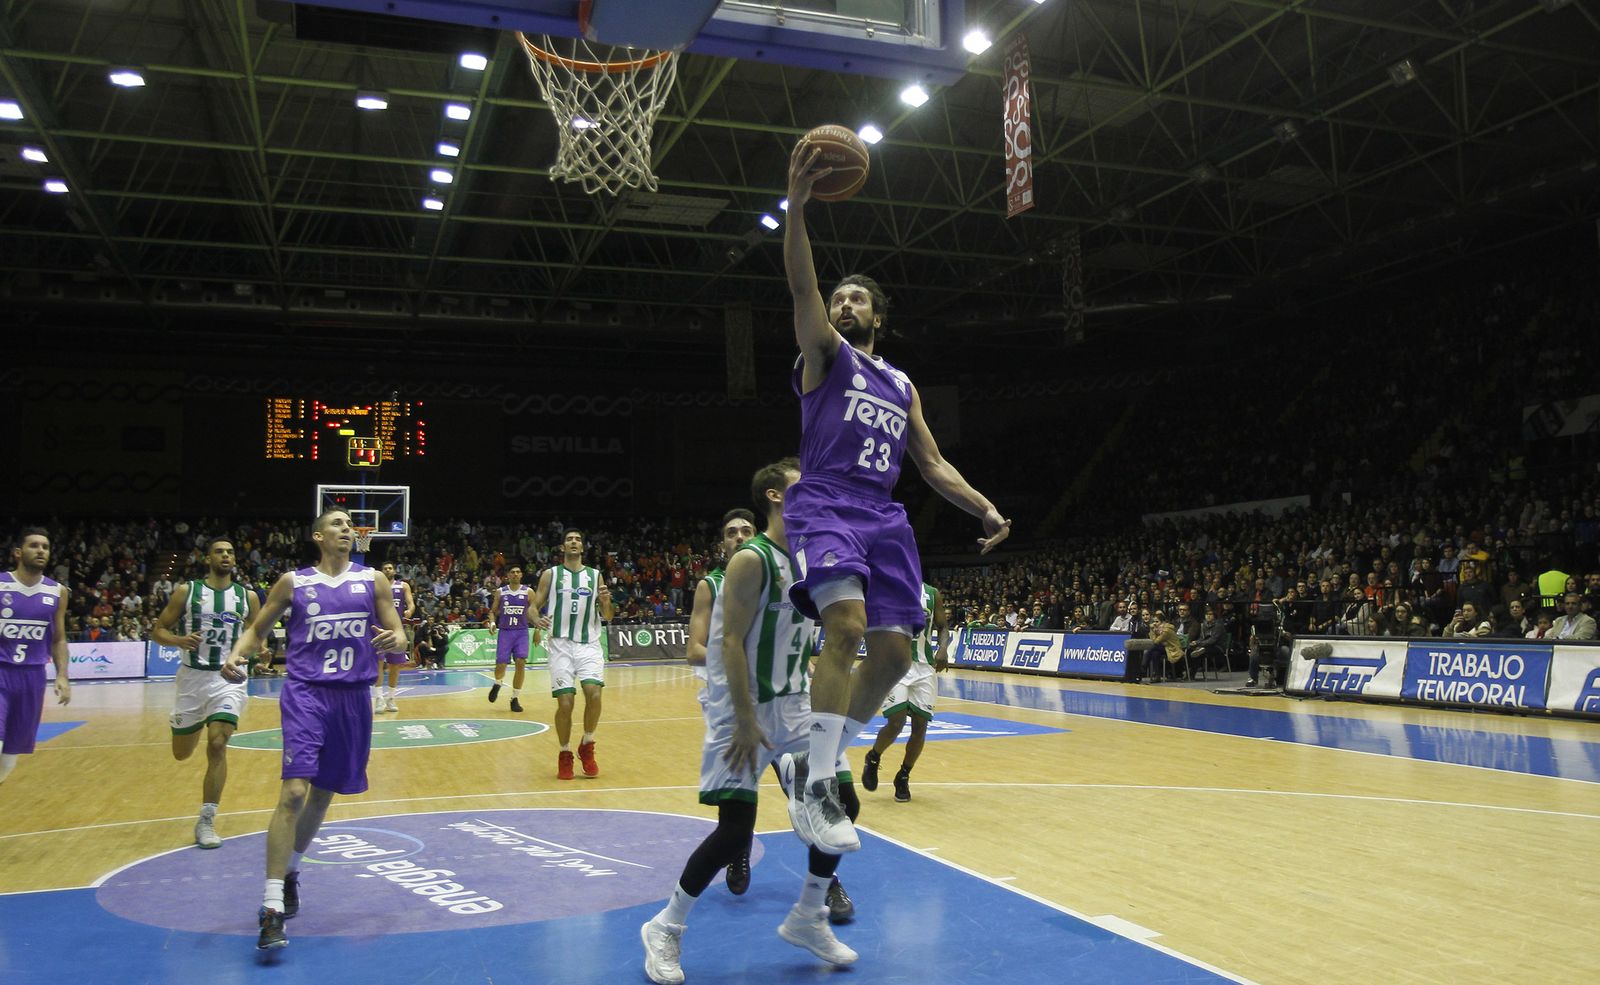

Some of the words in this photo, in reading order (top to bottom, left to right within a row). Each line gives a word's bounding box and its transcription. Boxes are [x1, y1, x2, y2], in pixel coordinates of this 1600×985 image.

[844, 390, 907, 440] Teka
[511, 435, 625, 454] SEVILLA
[858, 437, 891, 472] 23
[571, 601, 578, 613] 8
[305, 612, 371, 643] Teka
[509, 617, 518, 626] 14
[206, 629, 227, 645] 24
[791, 627, 801, 651] 4
[971, 633, 994, 646] FUERZA
[995, 634, 1005, 646] DE
[13, 644, 28, 663] 5
[323, 646, 354, 674] 20
[972, 649, 998, 662] EQUIPO
[1063, 646, 1126, 663] www.faster.es
[1428, 652, 1525, 680] TRABAJO
[1416, 679, 1529, 708] TEMPORAL
[312, 834, 406, 859] plus
[355, 859, 504, 915] energía
